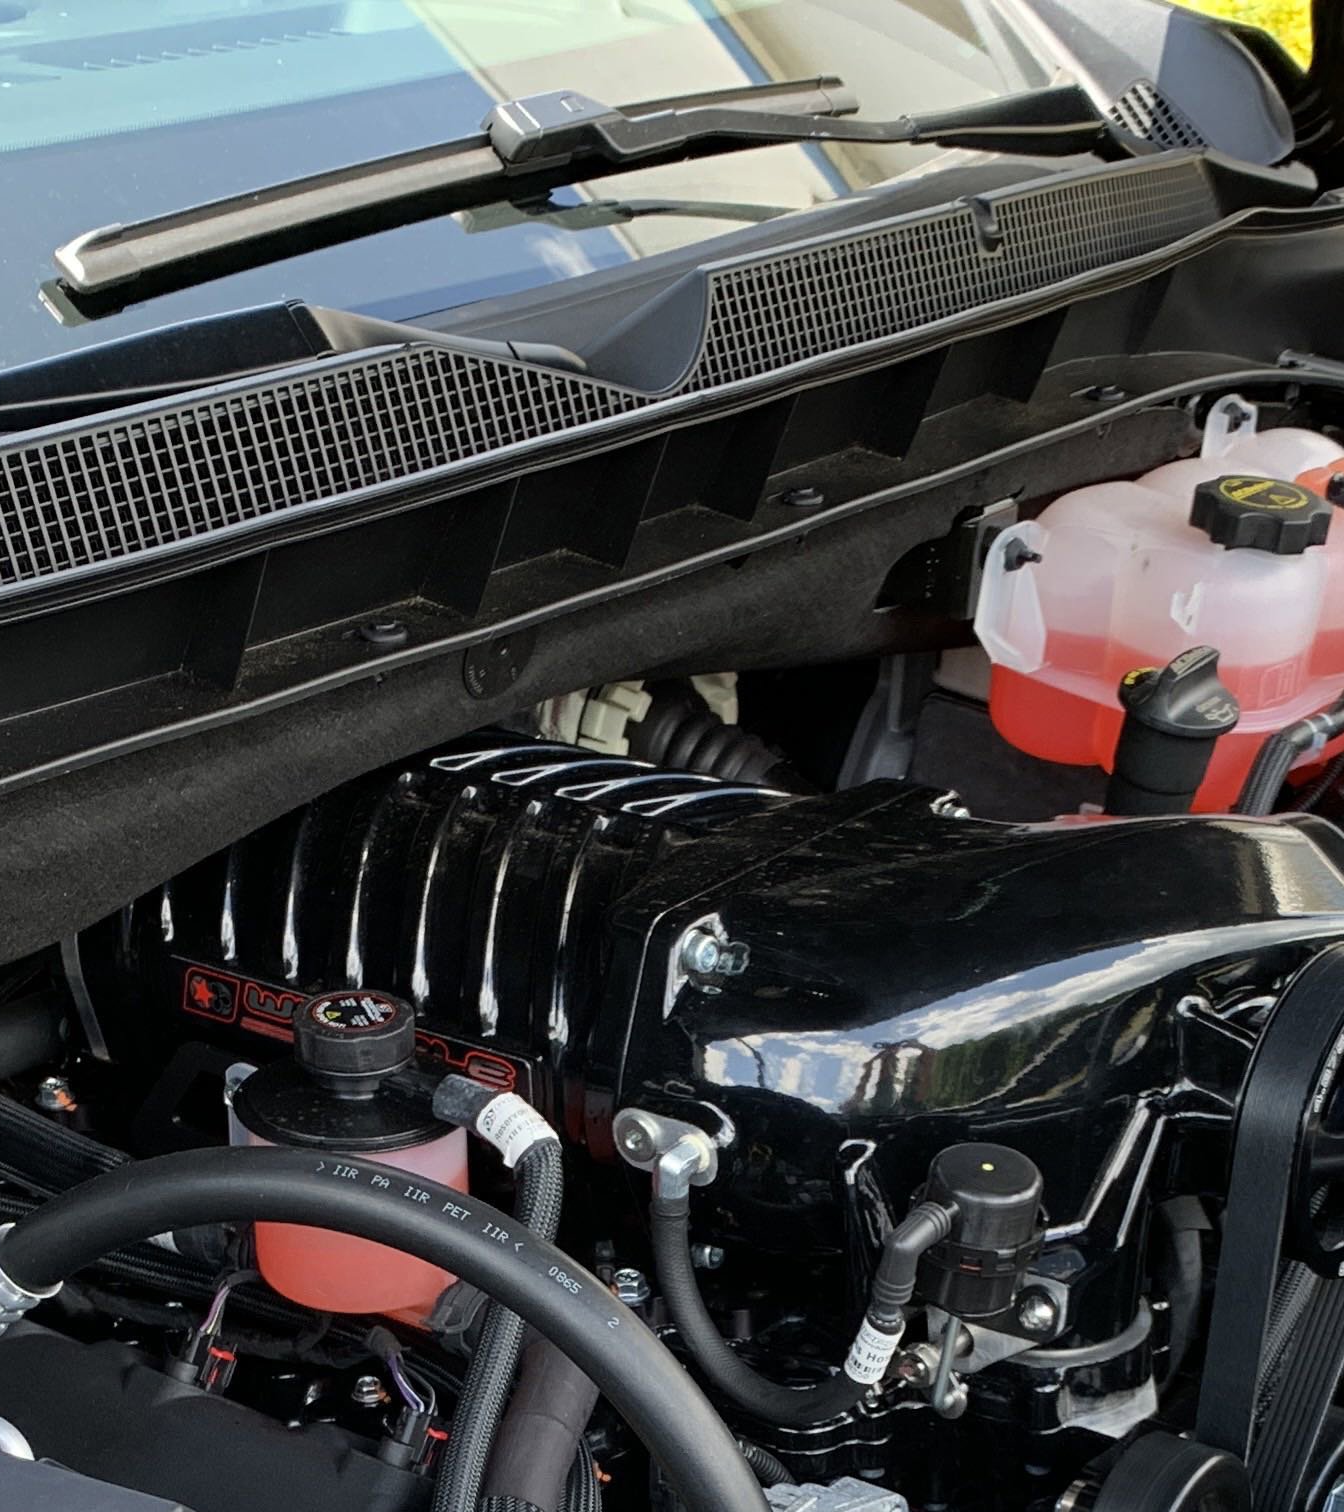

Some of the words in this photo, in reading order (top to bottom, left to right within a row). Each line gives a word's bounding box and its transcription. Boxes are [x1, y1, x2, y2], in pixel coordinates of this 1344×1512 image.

[333, 1164, 359, 1180] IIR
[370, 1174, 391, 1189] PA
[404, 1185, 431, 1204] IIR
[442, 1202, 471, 1221] PET
[482, 1222, 510, 1244] IIR
[548, 1265, 583, 1295] 0865
[607, 1316, 620, 1329] 2
